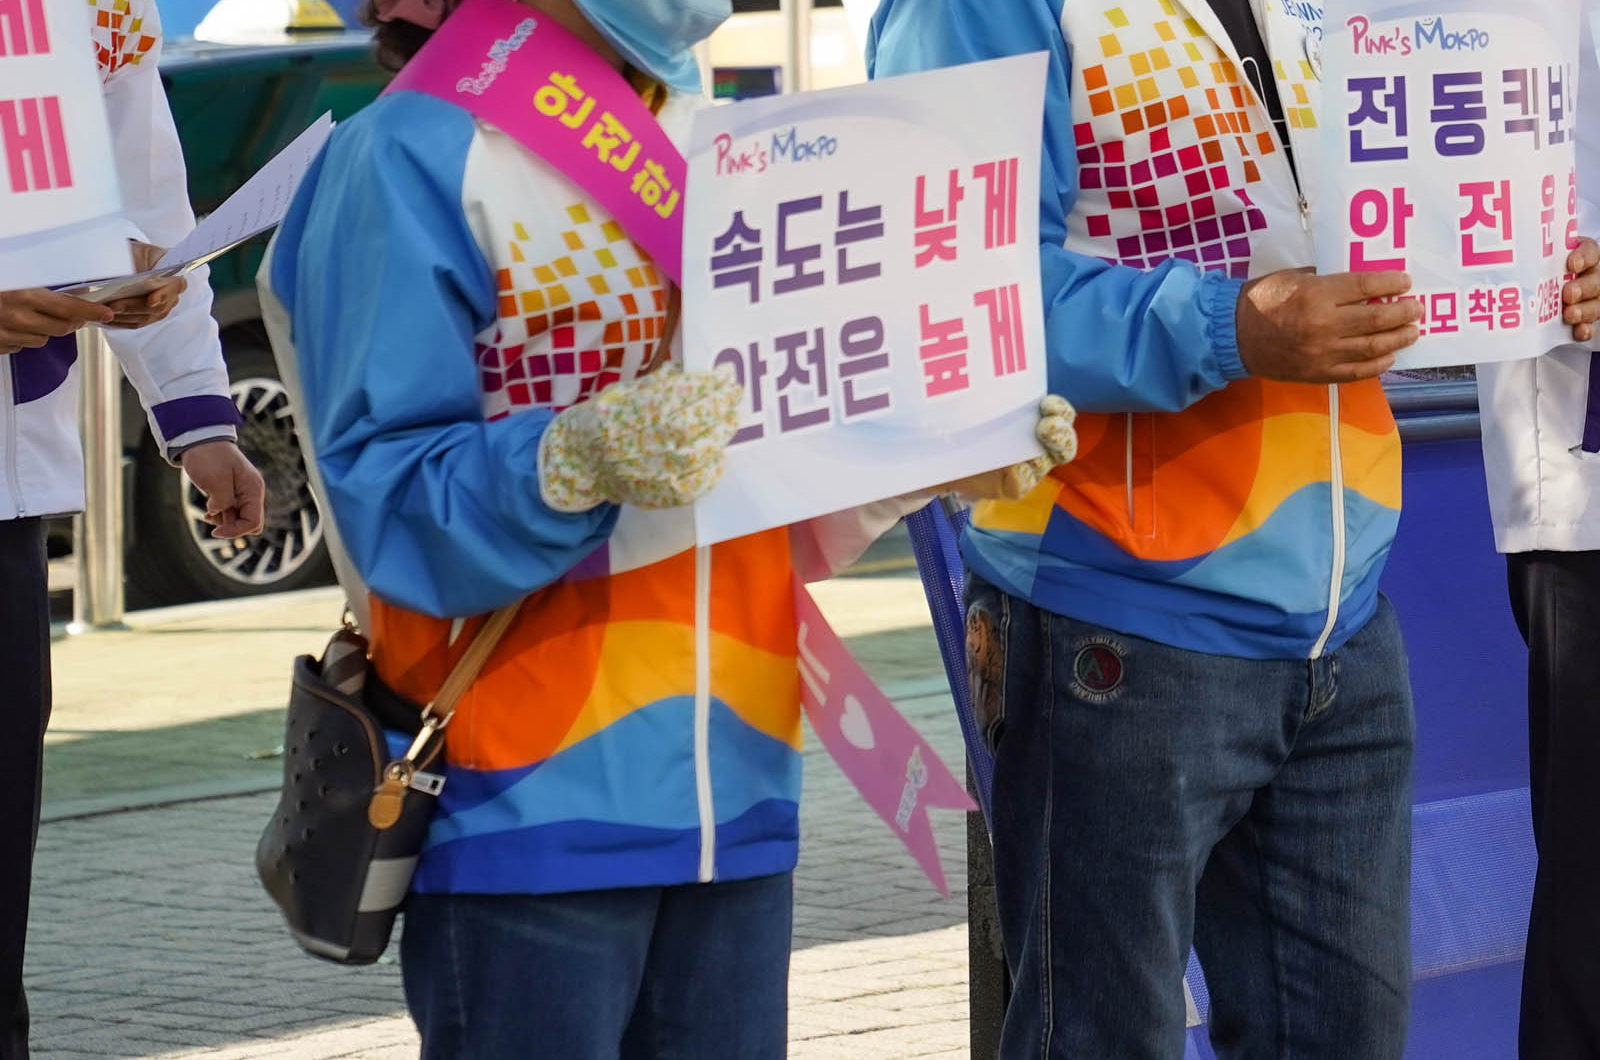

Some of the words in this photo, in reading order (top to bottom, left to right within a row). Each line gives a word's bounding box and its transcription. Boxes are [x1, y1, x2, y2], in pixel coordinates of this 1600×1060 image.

[1347, 64, 1573, 163] 전동킥보
[711, 190, 885, 304] 속도는
[914, 157, 1019, 268] 낮게
[713, 315, 890, 445] 안전은
[919, 283, 1027, 399] 높게
[1468, 286, 1521, 331] 착용
